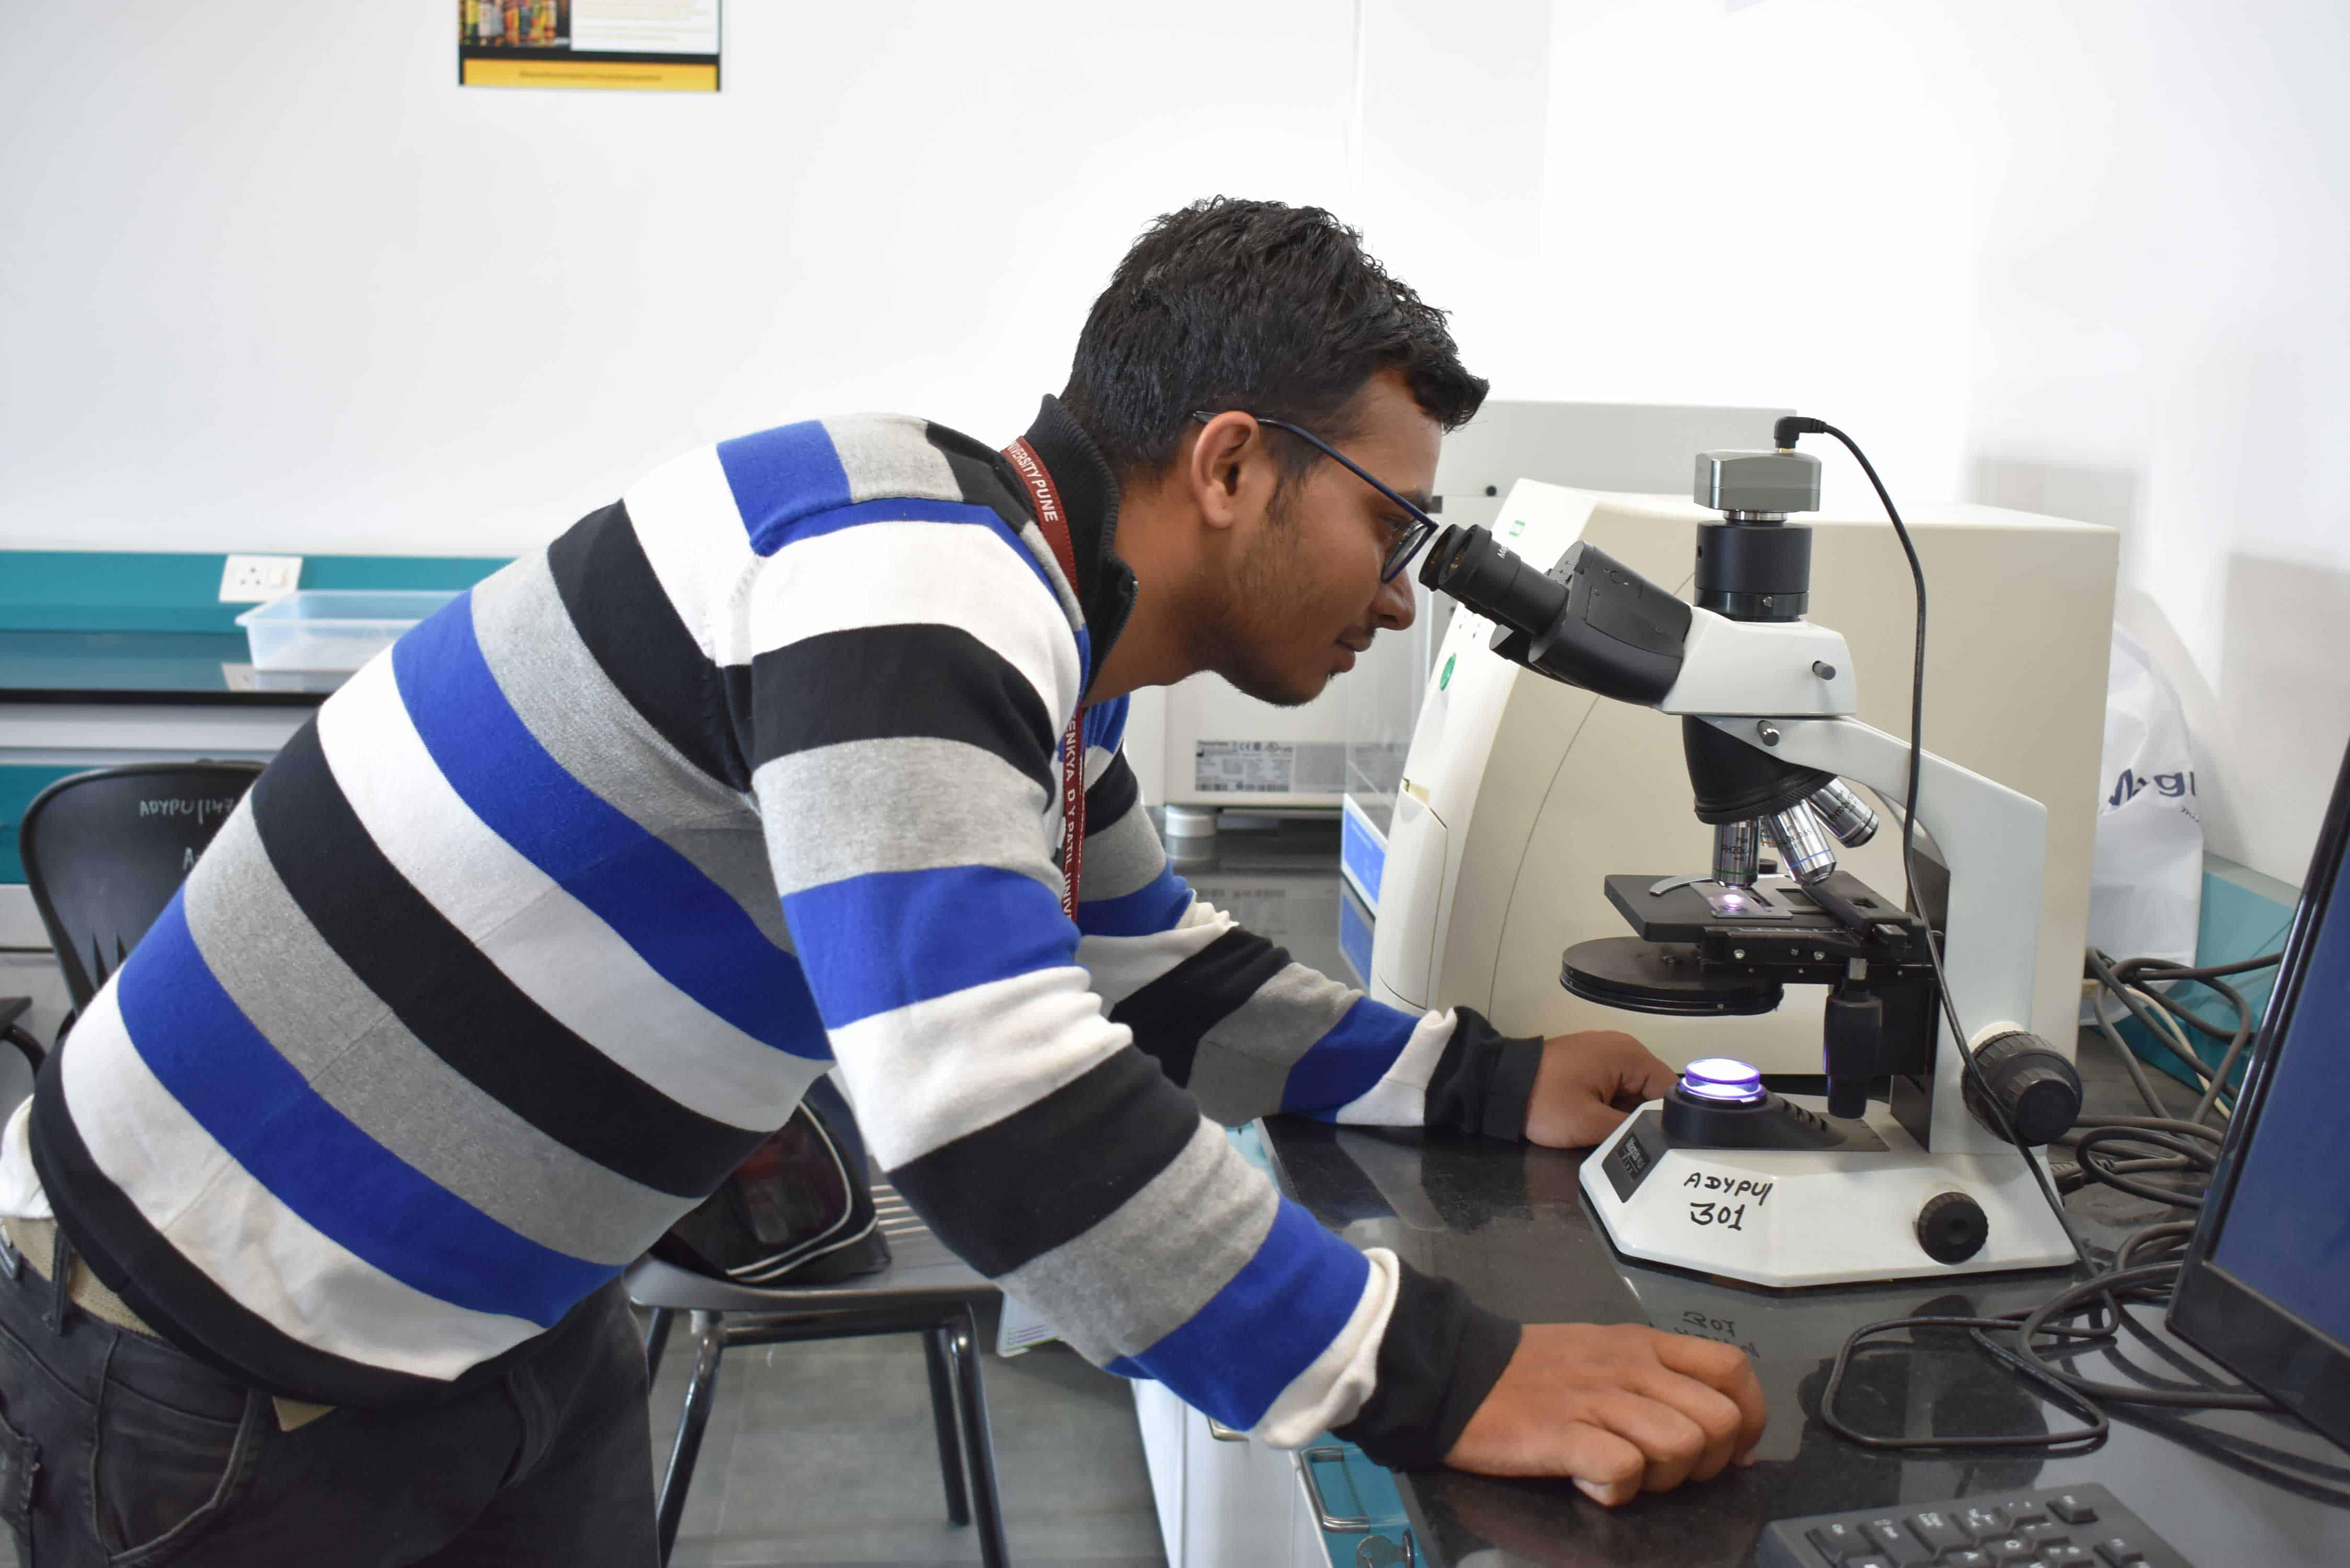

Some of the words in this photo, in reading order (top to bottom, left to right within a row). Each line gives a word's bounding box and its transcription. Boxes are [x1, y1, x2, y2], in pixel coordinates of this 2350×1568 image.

[1031, 479, 1058, 522] PUNE
[1065, 821, 1075, 871] PATIL
[1690, 1202, 1745, 1231] 301
